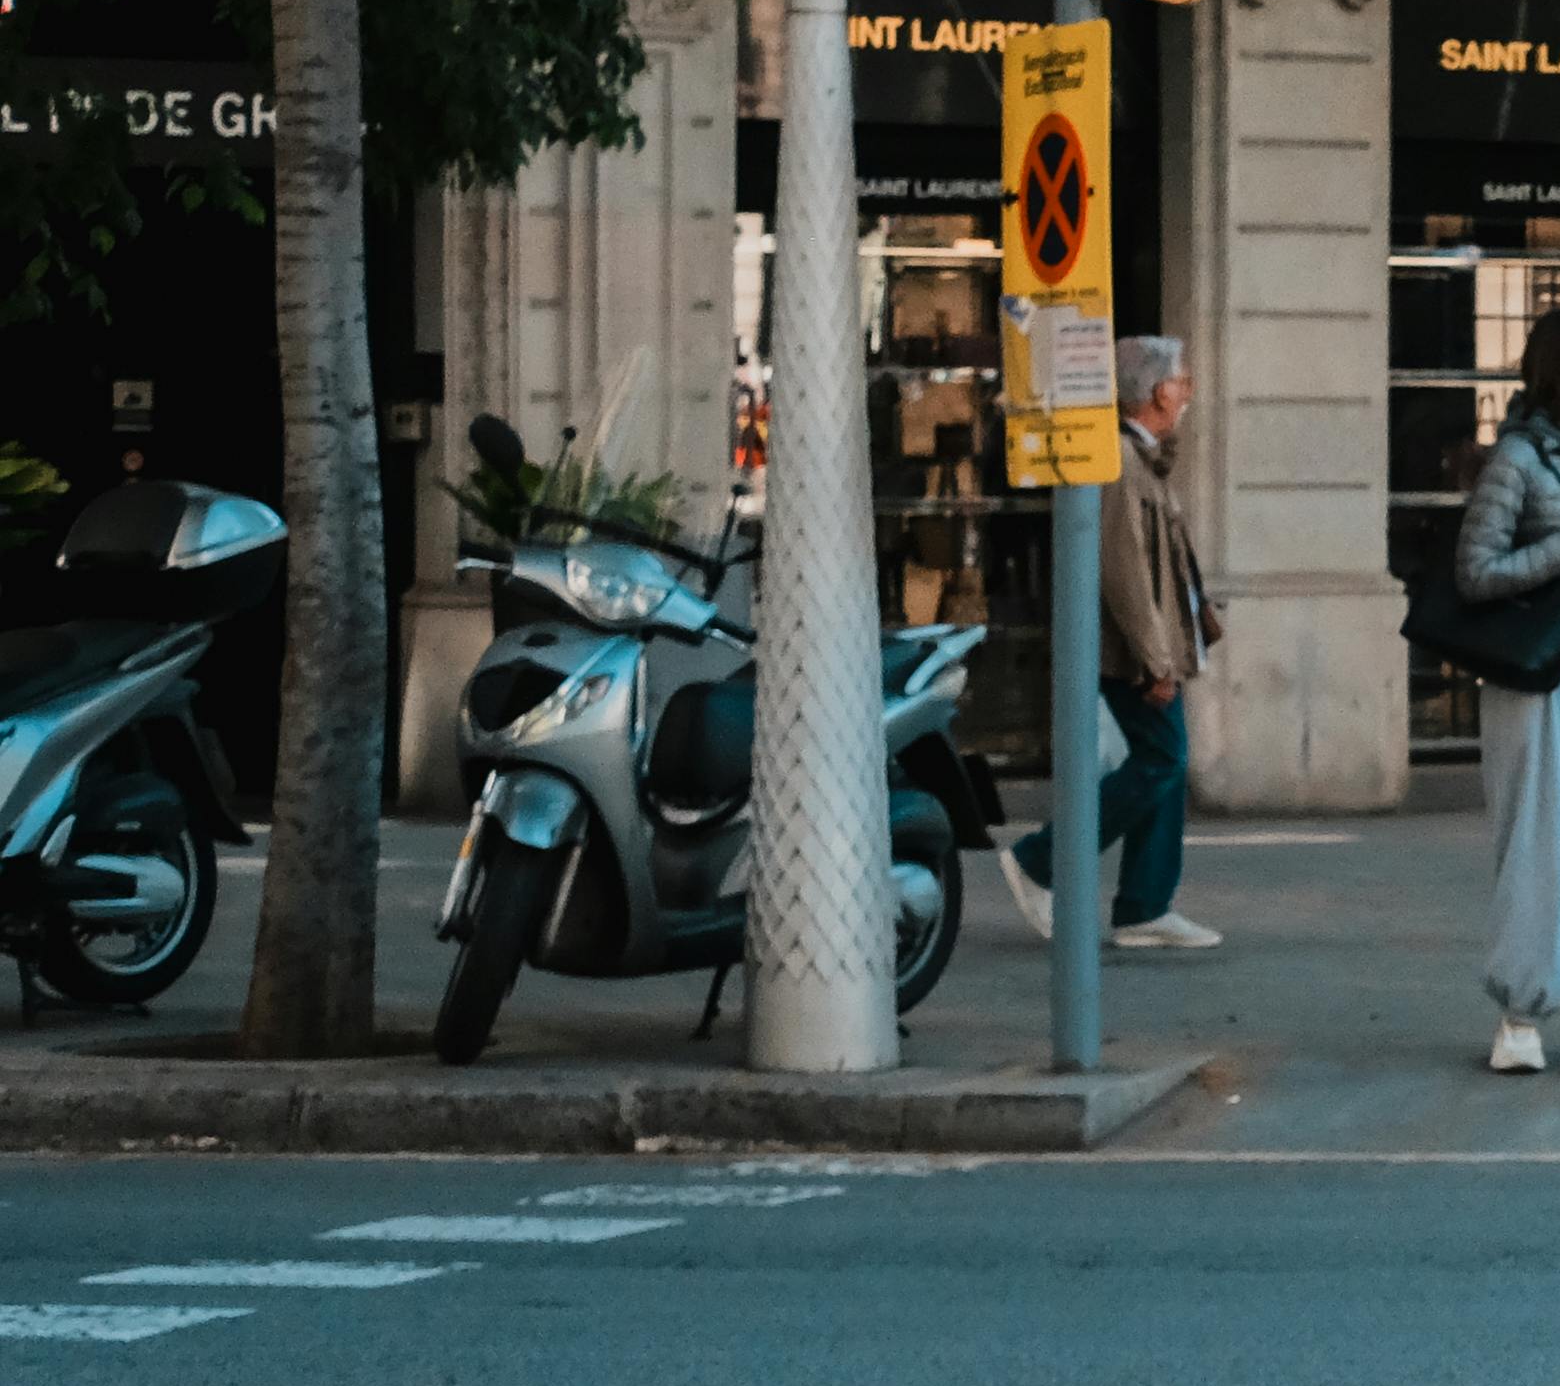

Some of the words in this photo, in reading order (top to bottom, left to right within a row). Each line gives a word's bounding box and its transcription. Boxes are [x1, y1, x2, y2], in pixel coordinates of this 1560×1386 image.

[848, 16, 905, 50] INT
[1440, 37, 1532, 72] SAINT
[1482, 182, 1531, 202] SAINT
